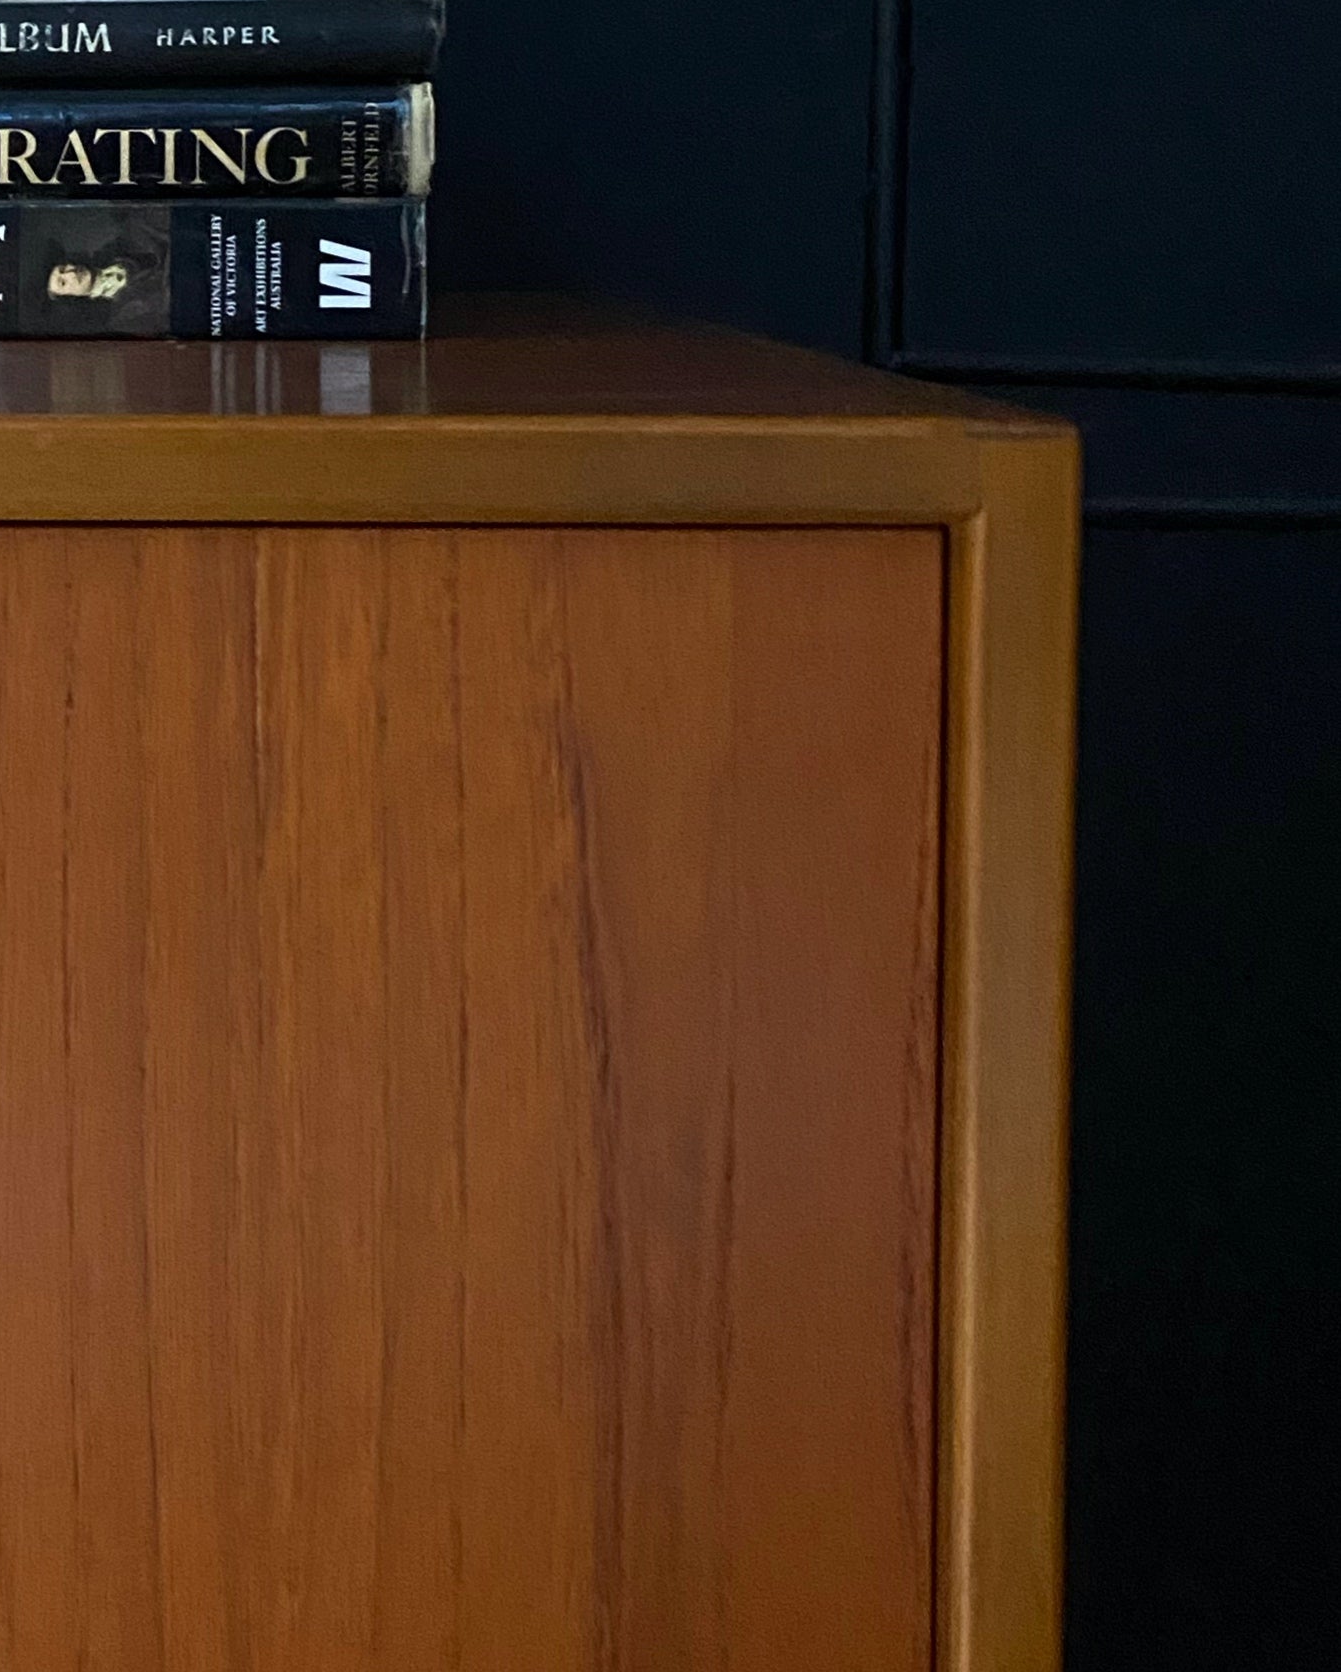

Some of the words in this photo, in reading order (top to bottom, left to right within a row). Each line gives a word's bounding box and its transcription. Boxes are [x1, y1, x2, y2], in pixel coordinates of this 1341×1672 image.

[156, 24, 281, 48] HARPER
[363, 102, 379, 195] ORNFELD
[210, 214, 222, 270] GALLERY
[225, 234, 237, 296] VICTORIA
[255, 218, 267, 305] EXHIBITIONS
[210, 273, 222, 336] NATIONAL
[270, 241, 282, 310] AUSTRALIA
[225, 300, 237, 316] OF
[255, 309, 267, 333] ART
